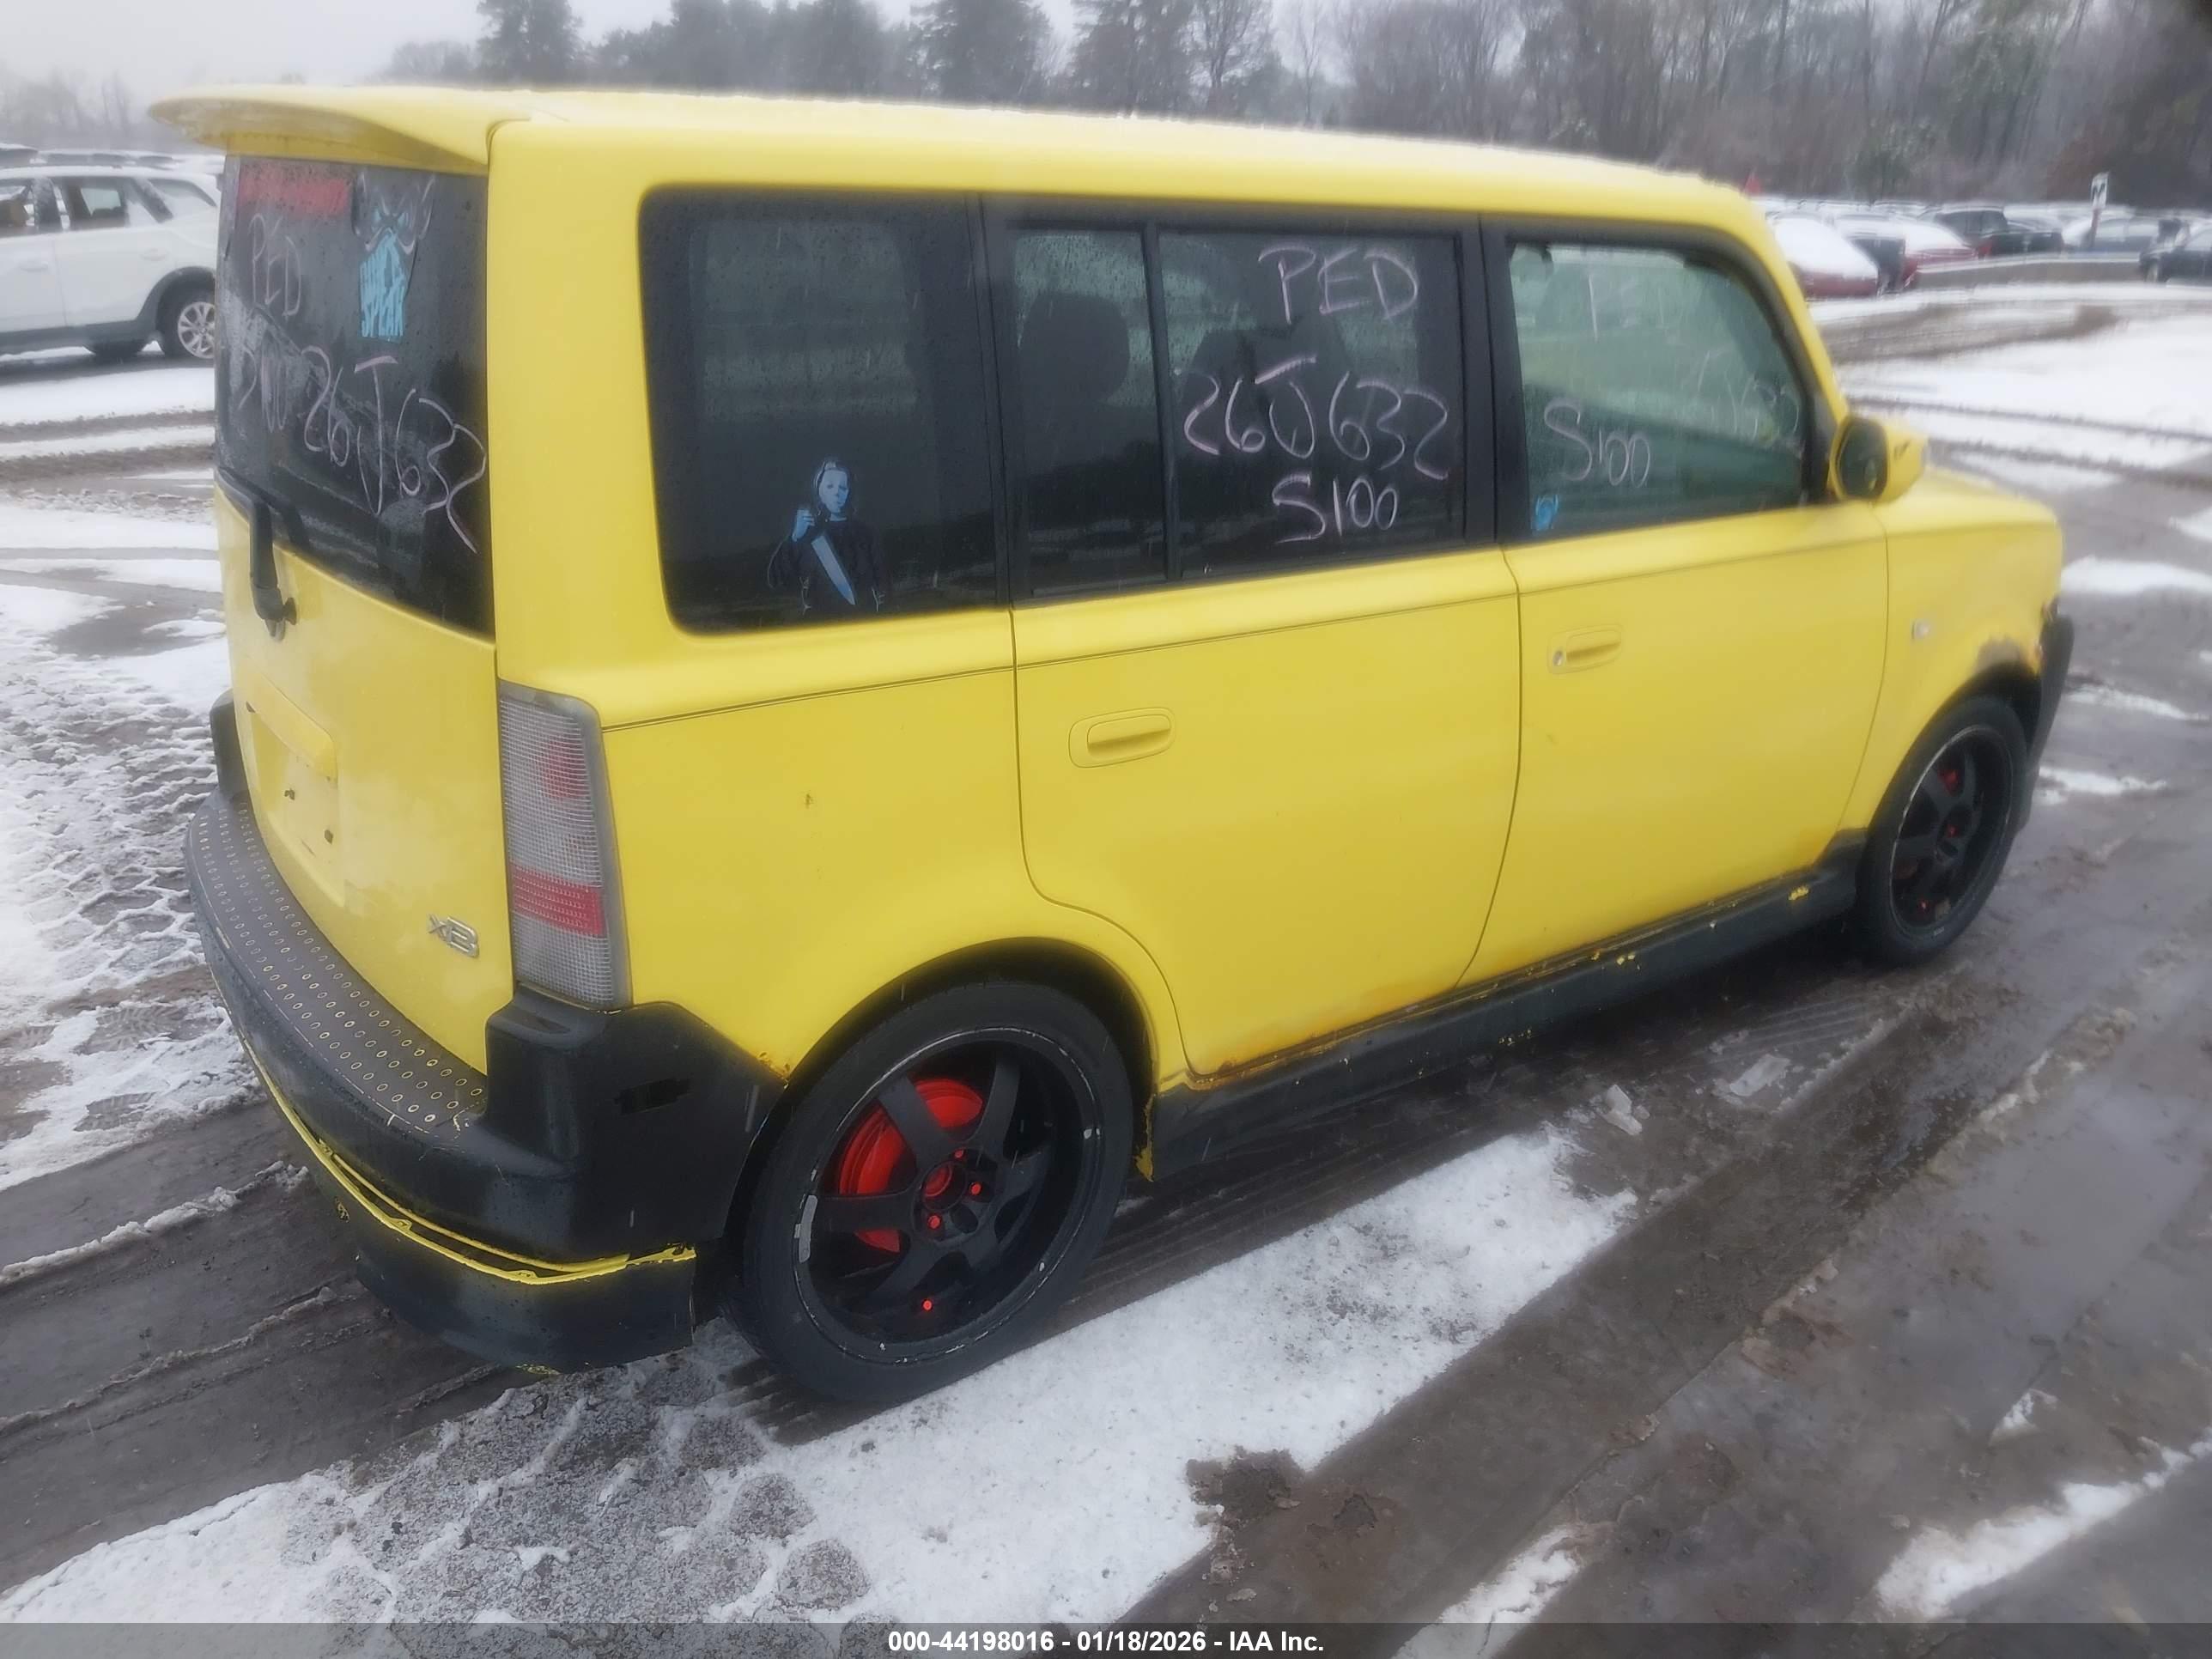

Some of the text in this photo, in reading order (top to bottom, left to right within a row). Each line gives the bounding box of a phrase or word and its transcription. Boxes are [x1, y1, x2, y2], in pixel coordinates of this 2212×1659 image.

[249, 213, 301, 319] PED
[1257, 244, 1419, 325] PED
[1544, 398, 1650, 488] S100
[1272, 471, 1399, 544] S100
